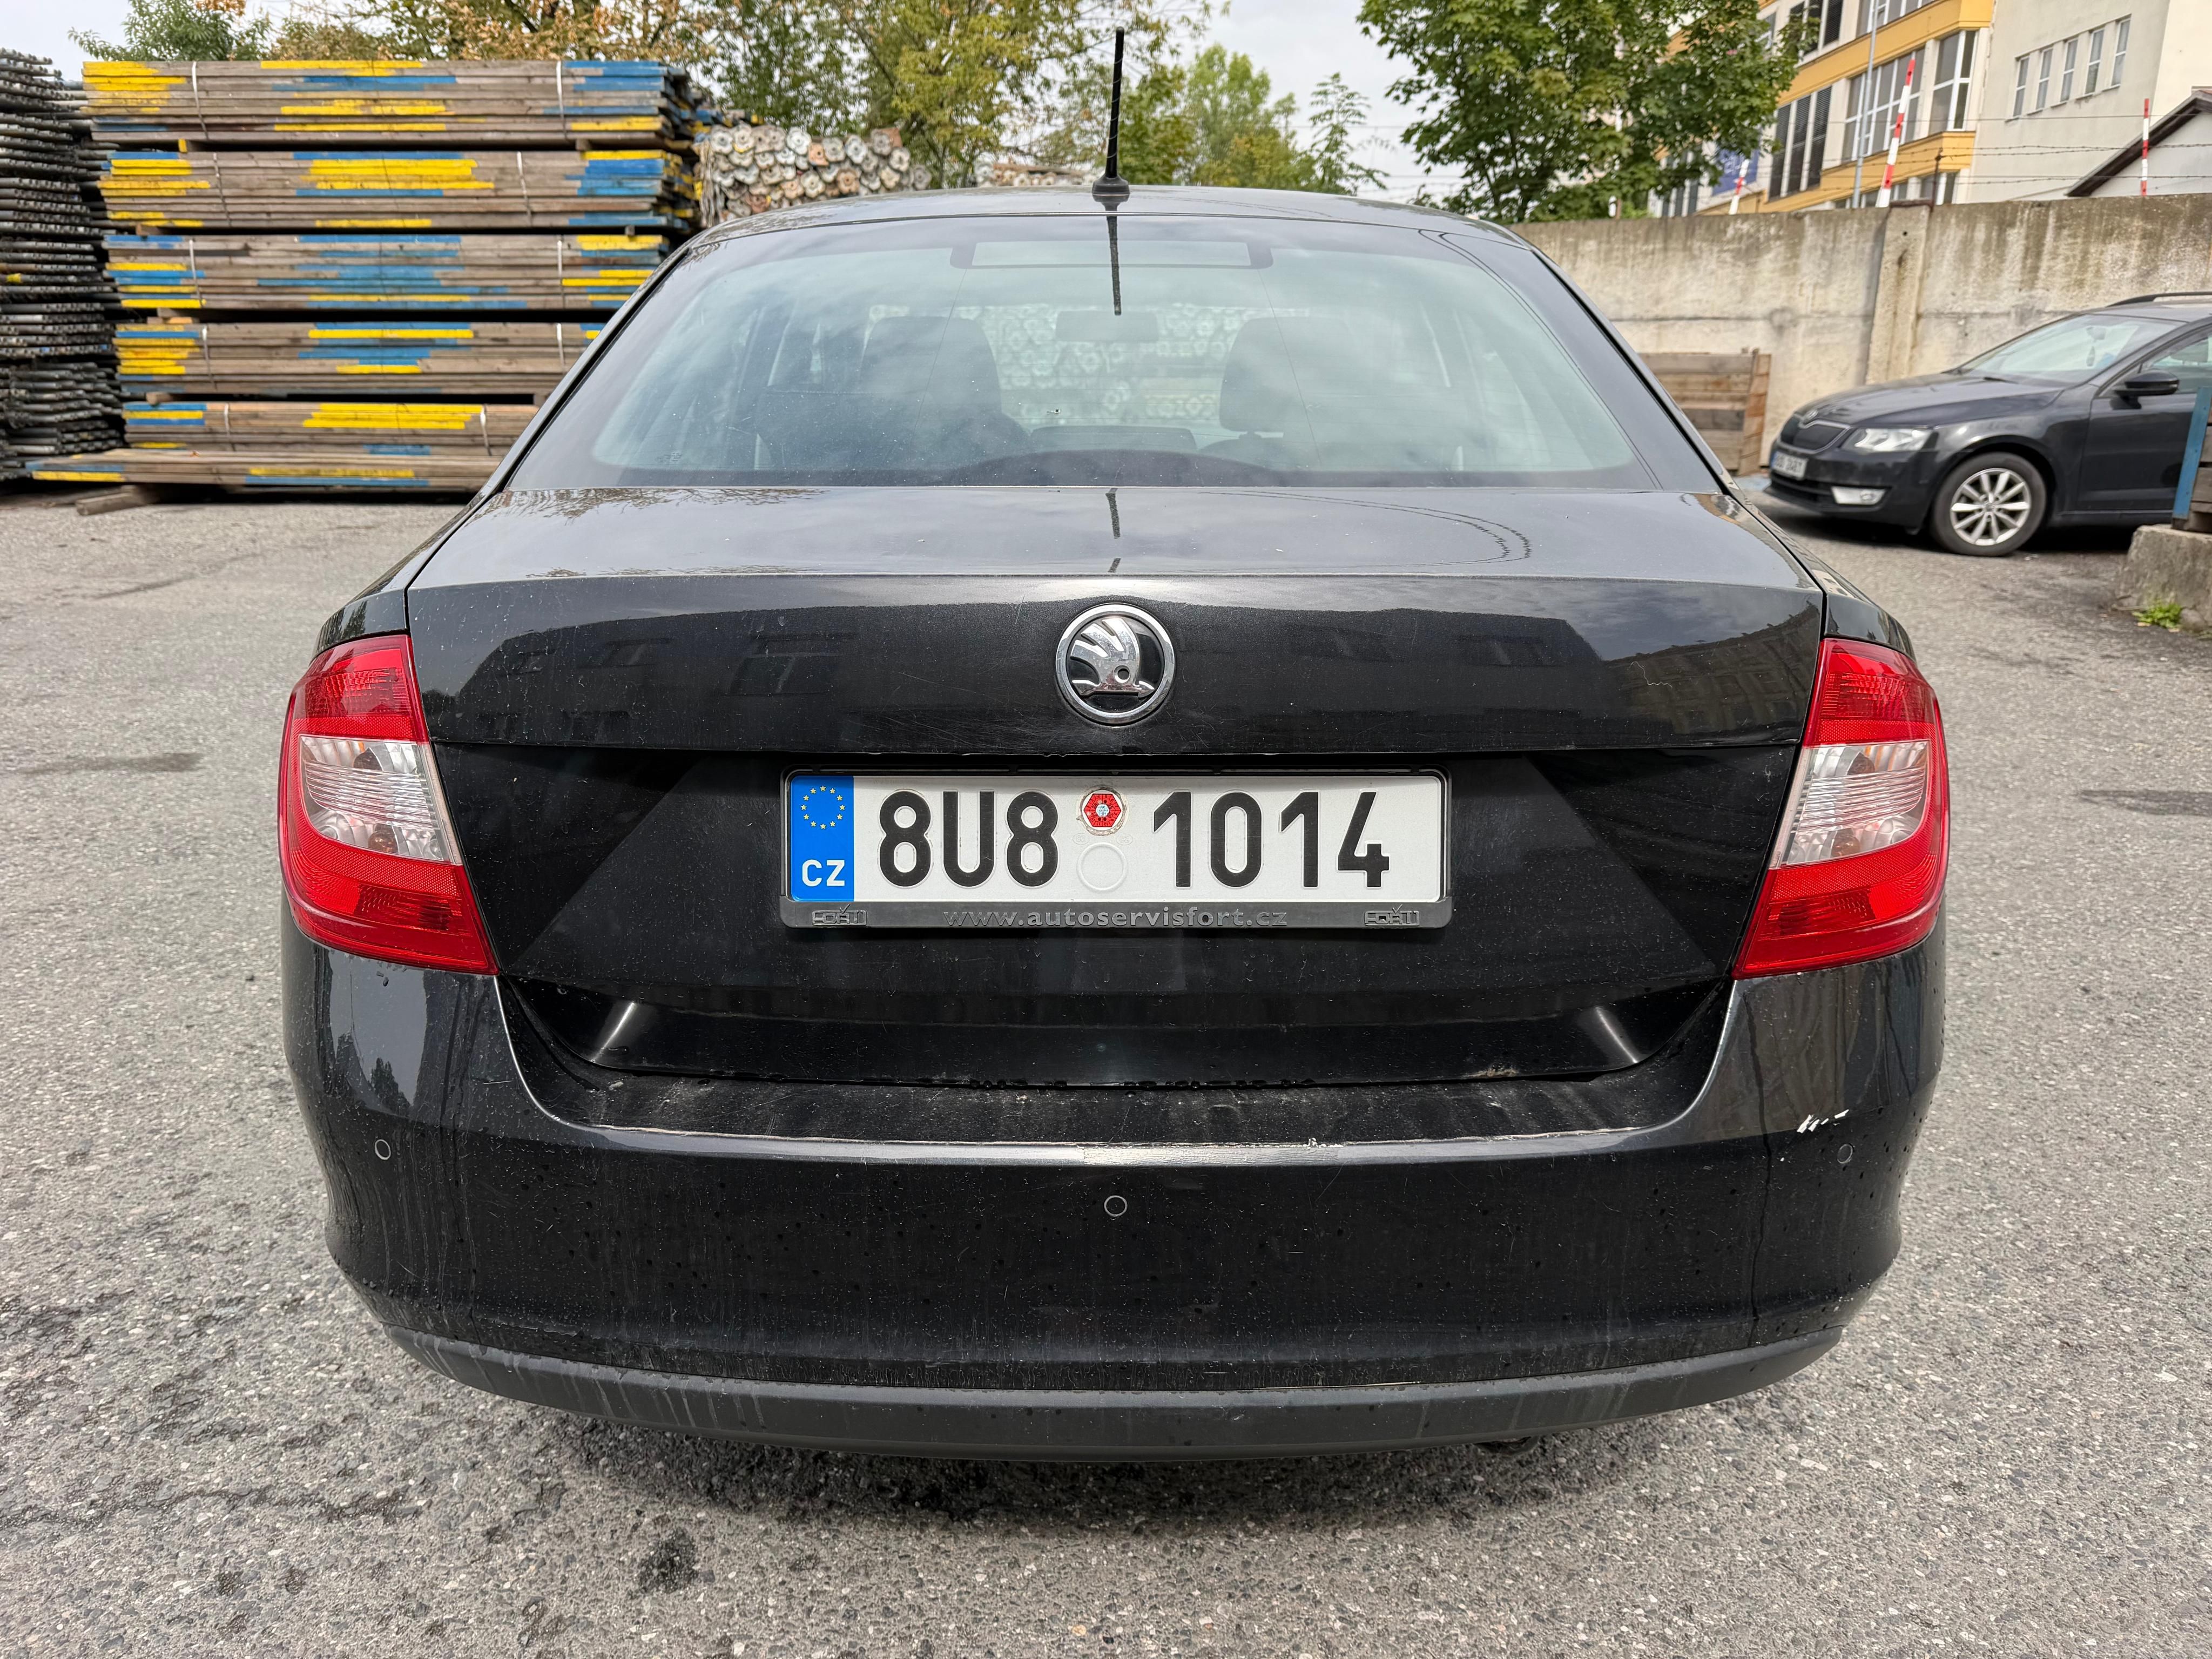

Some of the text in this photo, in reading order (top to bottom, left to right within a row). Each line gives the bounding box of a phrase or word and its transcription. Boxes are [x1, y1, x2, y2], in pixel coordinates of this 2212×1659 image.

[879, 791, 1390, 887] 8U8 1014
[802, 859, 845, 886] CZ
[943, 906, 1288, 927] www.autoservisfort.cz
